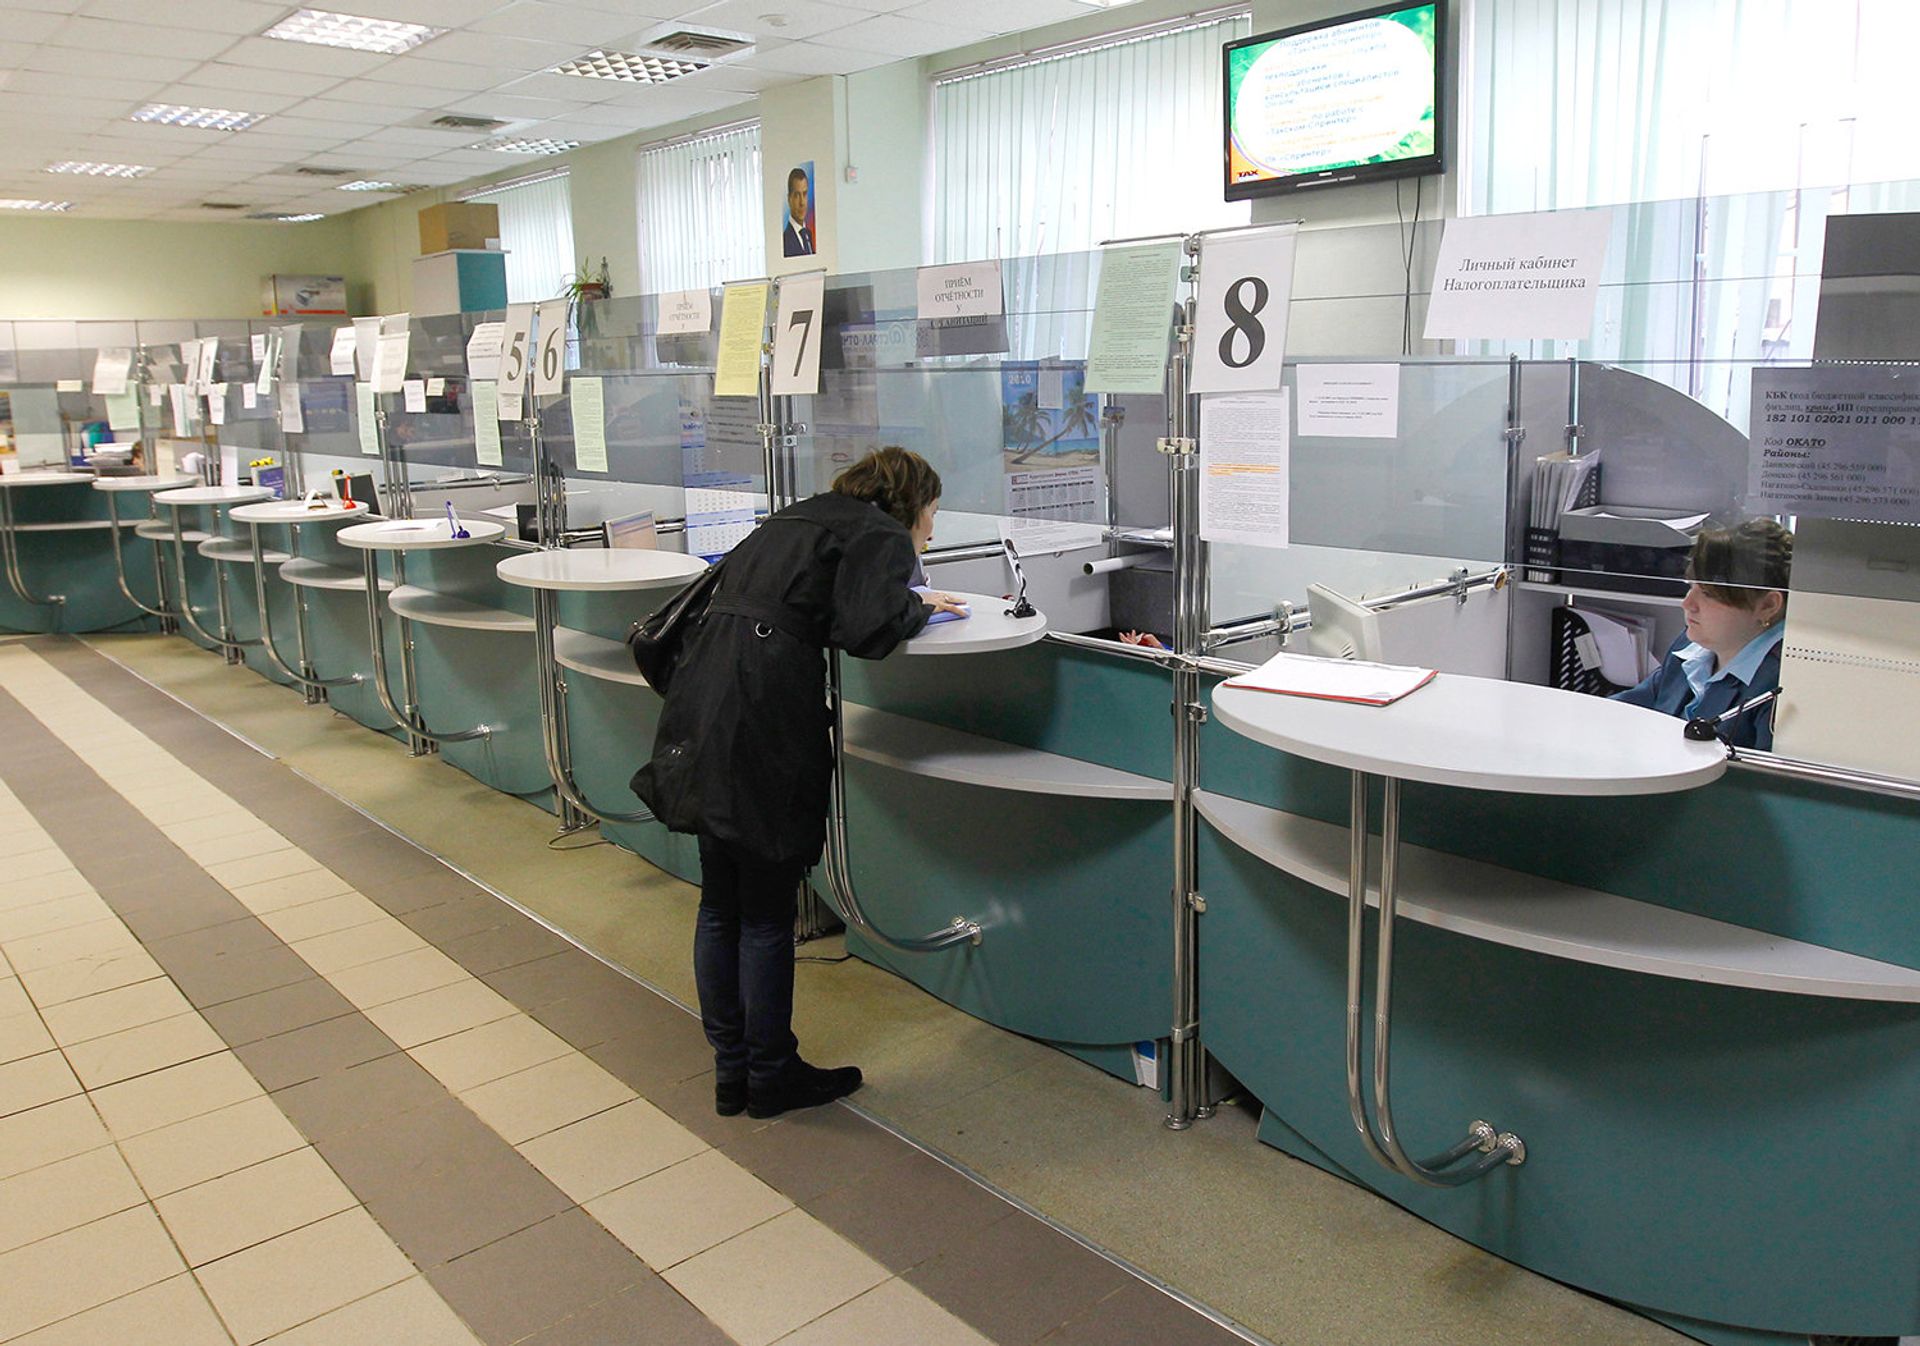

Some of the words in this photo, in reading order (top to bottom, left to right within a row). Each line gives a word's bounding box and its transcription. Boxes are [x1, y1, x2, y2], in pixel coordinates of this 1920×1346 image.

[1459, 256, 1515, 272] Личный
[1519, 255, 1577, 269] кабинет
[1443, 277, 1586, 292] Налогоплательщика
[1218, 276, 1269, 368] 8
[789, 309, 814, 377] 7
[507, 332, 525, 381] 5
[543, 327, 559, 381] 6
[1008, 374, 1032, 385] 2010
[1766, 391, 1787, 399] КБК
[1766, 414, 1786, 422] 182
[1791, 414, 1810, 423] 101
[1815, 414, 1850, 424] 02021
[1855, 415, 1877, 424] 011
[1882, 416, 1906, 424] 000
[1764, 437, 1783, 445] Код
[1786, 437, 1826, 447] ОКАТО
[1763, 449, 1810, 458] Районы:
